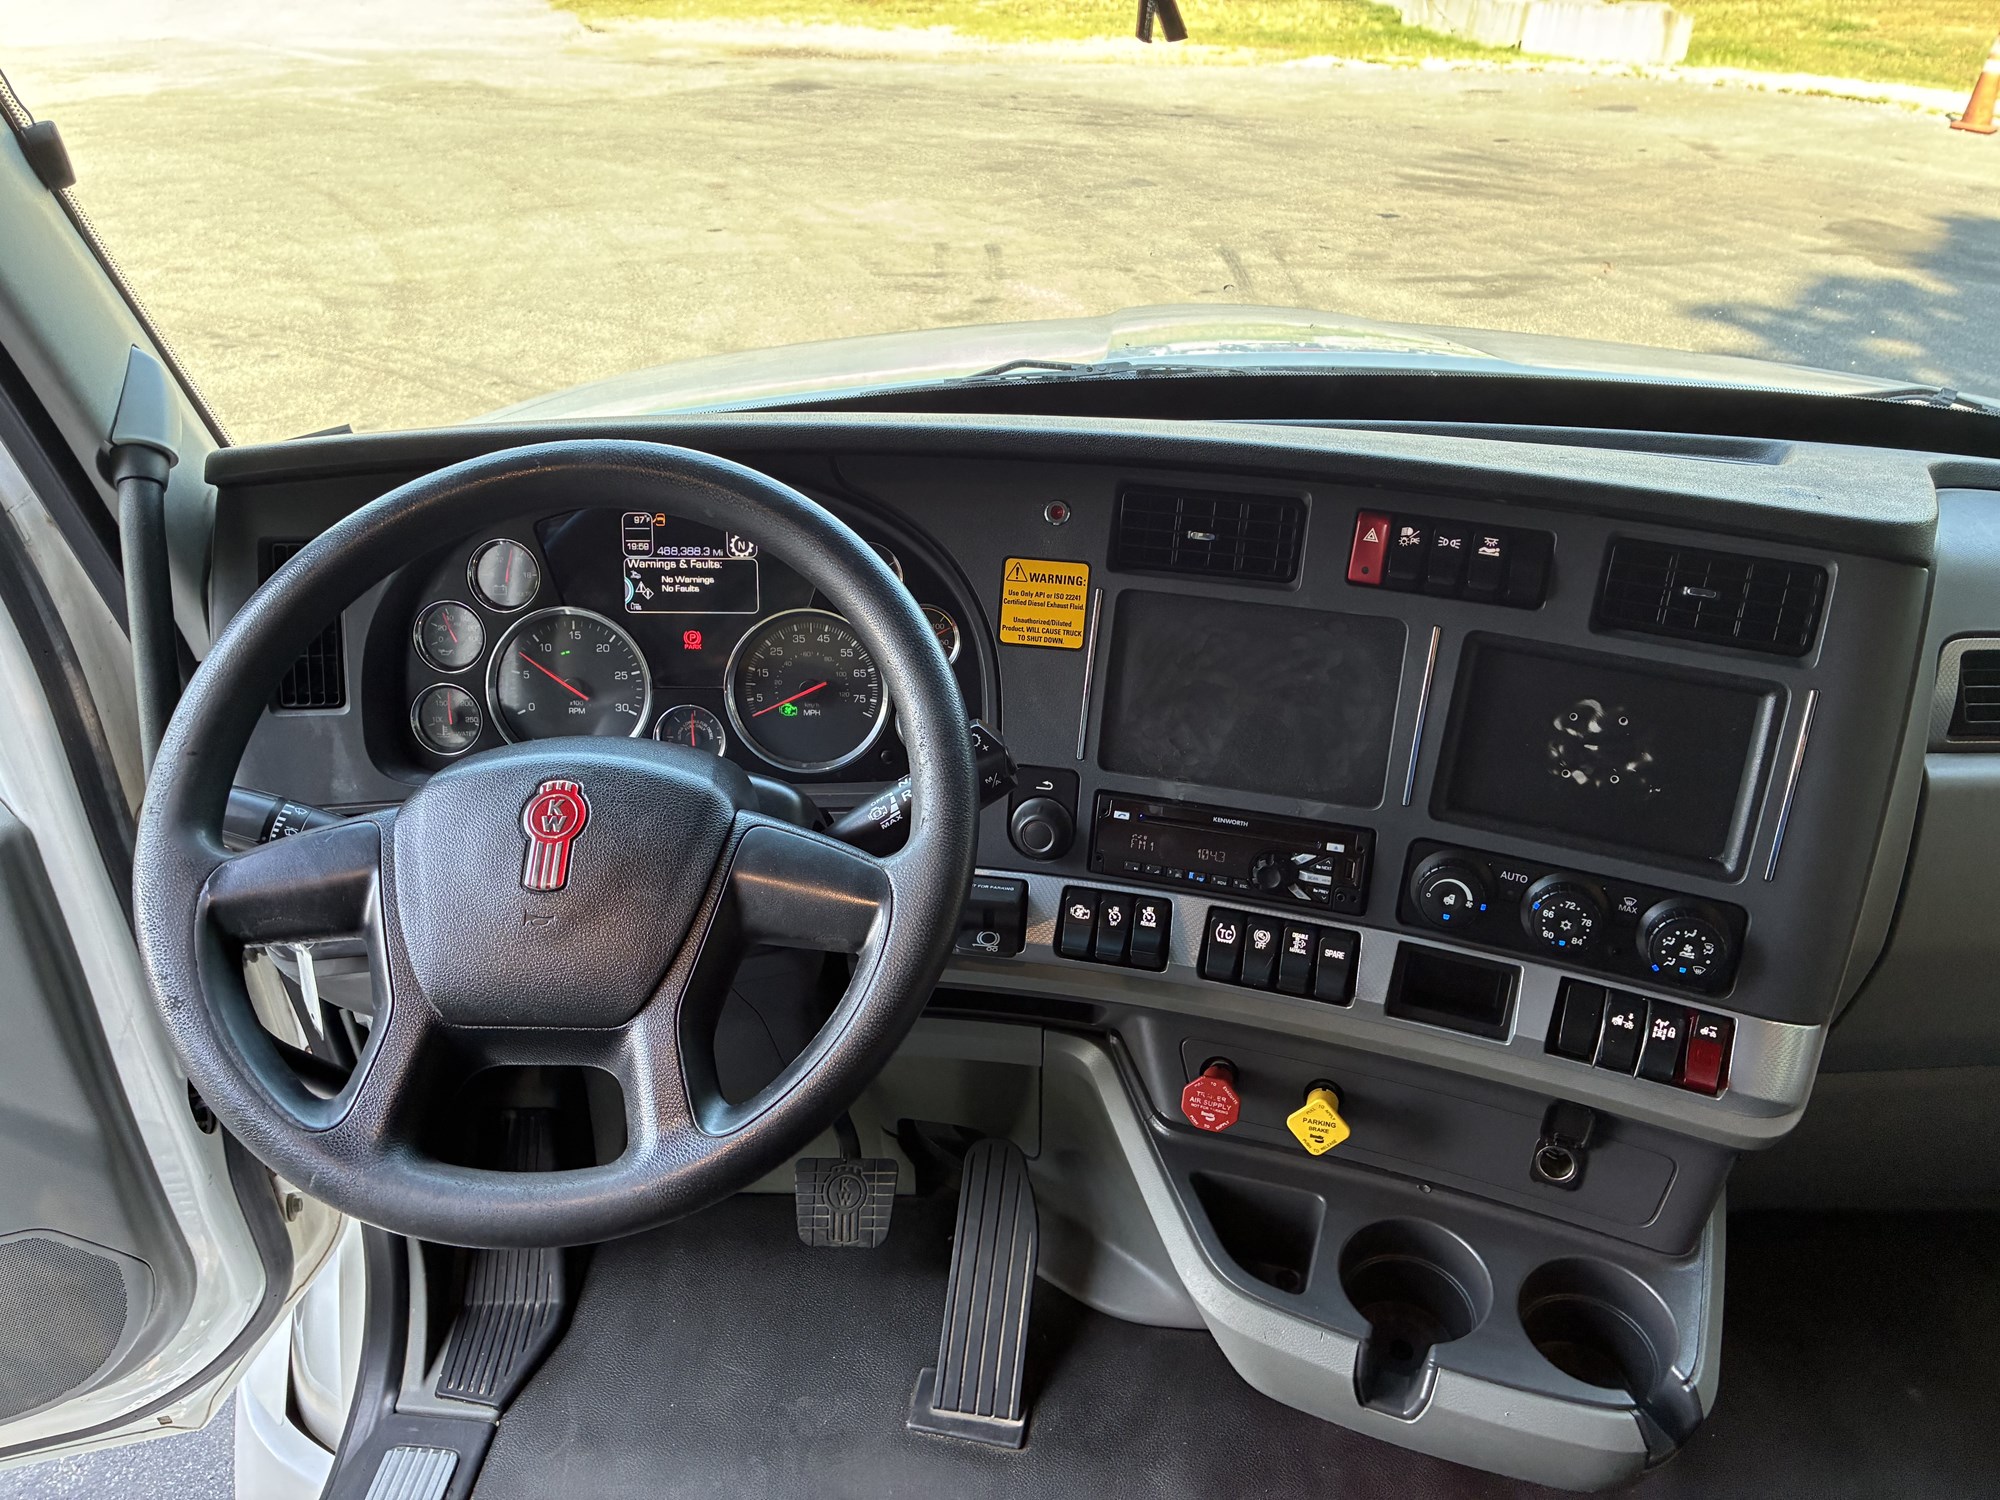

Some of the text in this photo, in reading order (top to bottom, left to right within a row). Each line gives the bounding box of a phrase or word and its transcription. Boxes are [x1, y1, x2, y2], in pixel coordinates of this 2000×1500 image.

[738, 541, 746, 550] N
[628, 559, 722, 570] Warnings & Faults:
[675, 576, 714, 585] Warnings
[1029, 572, 1087, 586] WARNING:
[675, 584, 700, 592] Faults
[1020, 590, 1033, 598] Only
[1004, 598, 1027, 606] Certified
[1028, 600, 1046, 608] Diesel
[1013, 616, 1072, 627] Unauthorized/Diluted
[569, 631, 582, 640] 15
[792, 634, 806, 643] 35
[816, 634, 830, 643] 45
[539, 644, 552, 652] 10
[596, 644, 610, 652] 20
[770, 648, 783, 656] 25
[840, 648, 854, 658] 55
[523, 670, 530, 679] 5
[614, 672, 628, 680] 25
[757, 668, 768, 678] 15
[854, 669, 866, 678] 65
[756, 694, 762, 702] 5
[854, 694, 866, 704] 75
[528, 703, 536, 711] 0
[985, 773, 1002, 788] M/A
[547, 798, 565, 816] K
[542, 815, 567, 832] W
[881, 814, 904, 830] MAX
[1212, 816, 1249, 827] KENWORTH
[1500, 871, 1528, 884] AUTO
[1565, 901, 1576, 910] 72
[1618, 904, 1638, 914] MAX
[1542, 909, 1554, 918] 66
[1581, 918, 1592, 927] 78
[1220, 928, 1232, 940] TC
[1542, 930, 1554, 939] 60
[1571, 937, 1583, 946] 84
[1288, 946, 1306, 955] MANUAL
[1324, 949, 1346, 960] SPARE
[1204, 1100, 1232, 1110] SUPPLY
[1302, 1118, 1336, 1128] PARKING
[1308, 1126, 1329, 1134] BRAKE
